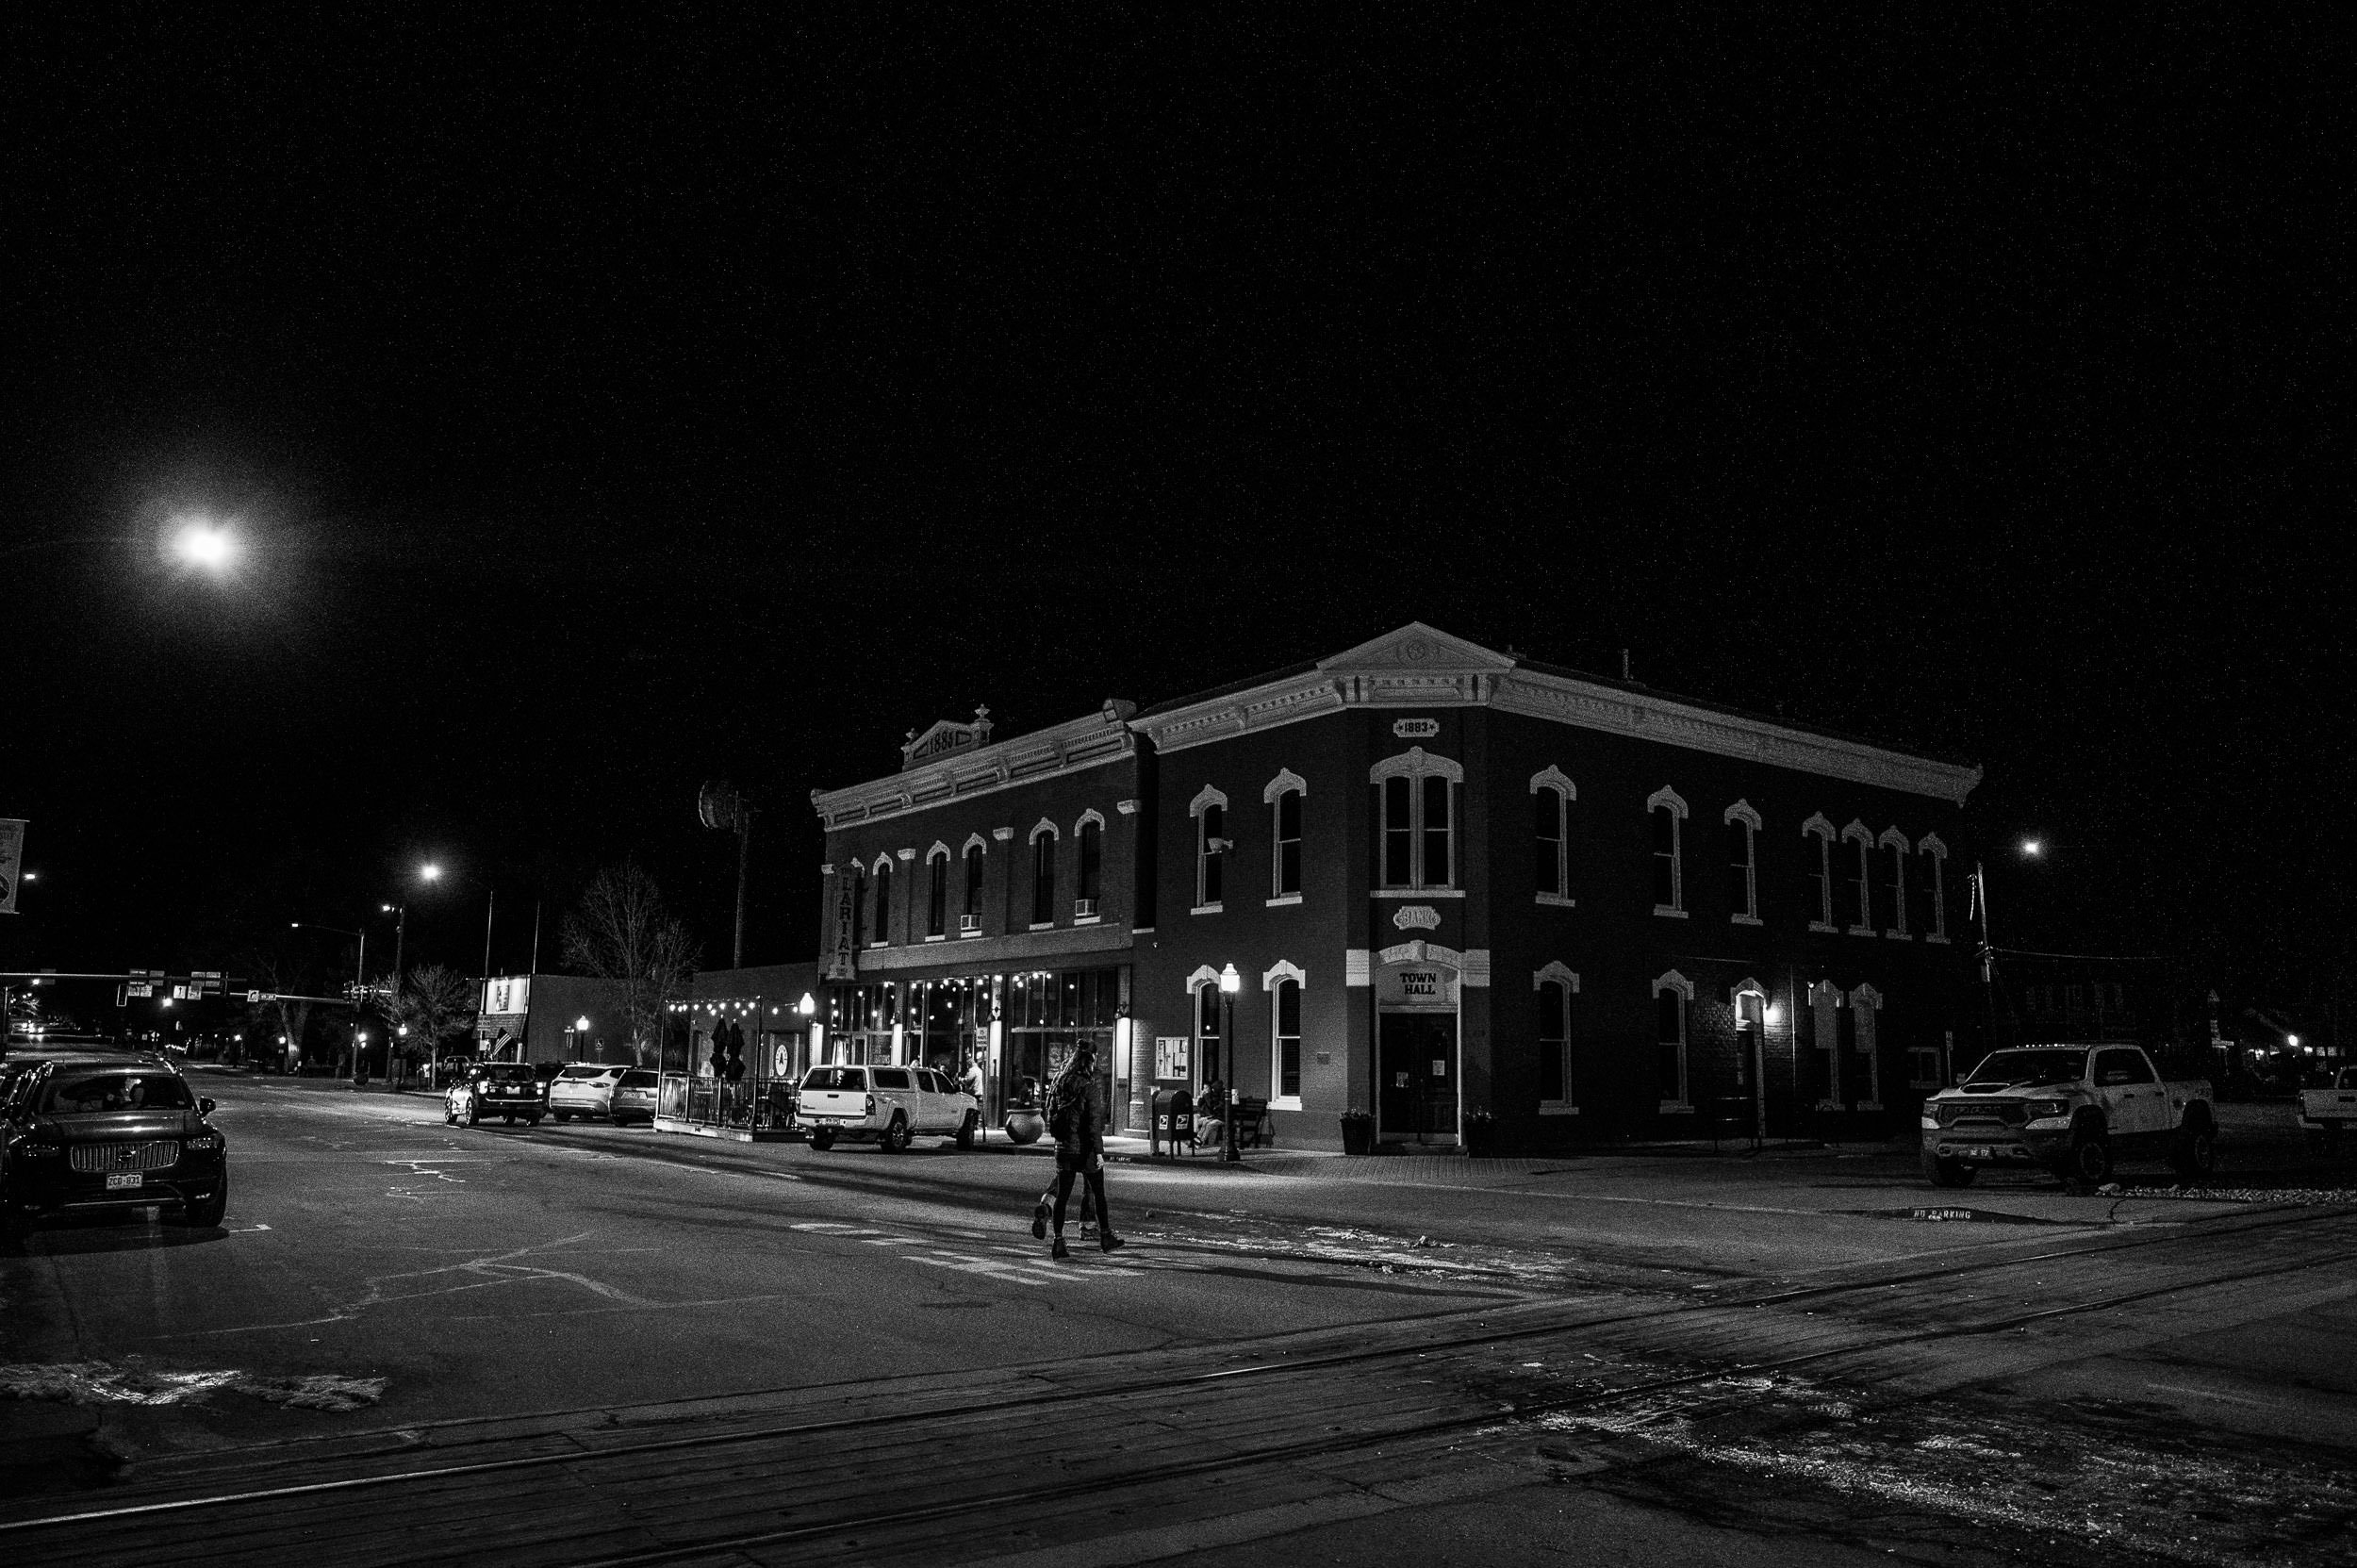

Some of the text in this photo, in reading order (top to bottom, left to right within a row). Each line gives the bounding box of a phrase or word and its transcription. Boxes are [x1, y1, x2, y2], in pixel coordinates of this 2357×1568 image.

[1405, 722, 1427, 733] 1883
[839, 877, 853, 966] LARIAT
[1399, 973, 1437, 983] TOWN
[1405, 984, 1436, 995] HALL
